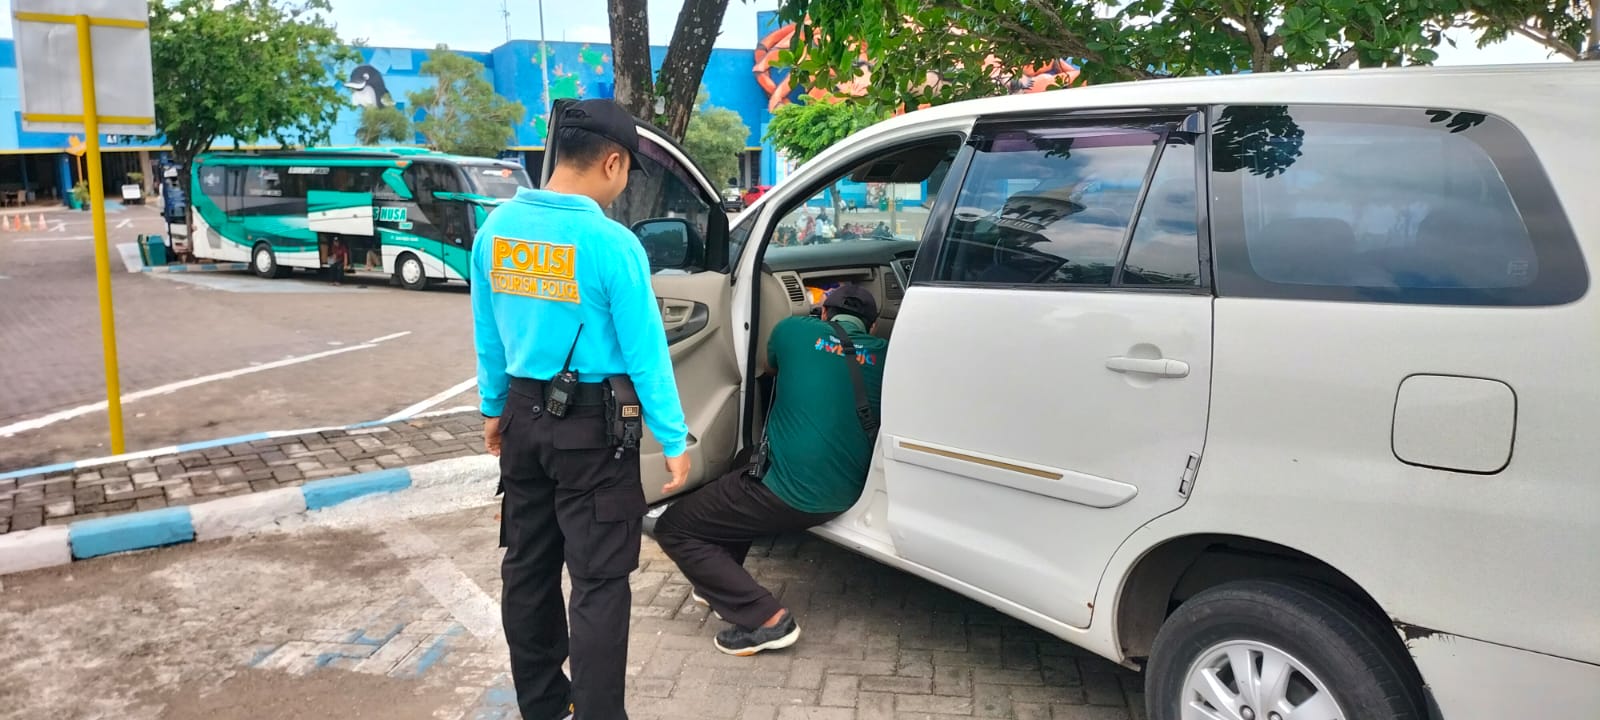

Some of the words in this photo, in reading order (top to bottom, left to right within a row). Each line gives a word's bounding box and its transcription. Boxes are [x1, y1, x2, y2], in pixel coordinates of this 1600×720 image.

[380, 206, 407, 221] NUSA
[494, 240, 575, 277] POLISI
[494, 275, 538, 293] TOURISM
[541, 280, 578, 299] POLICE
